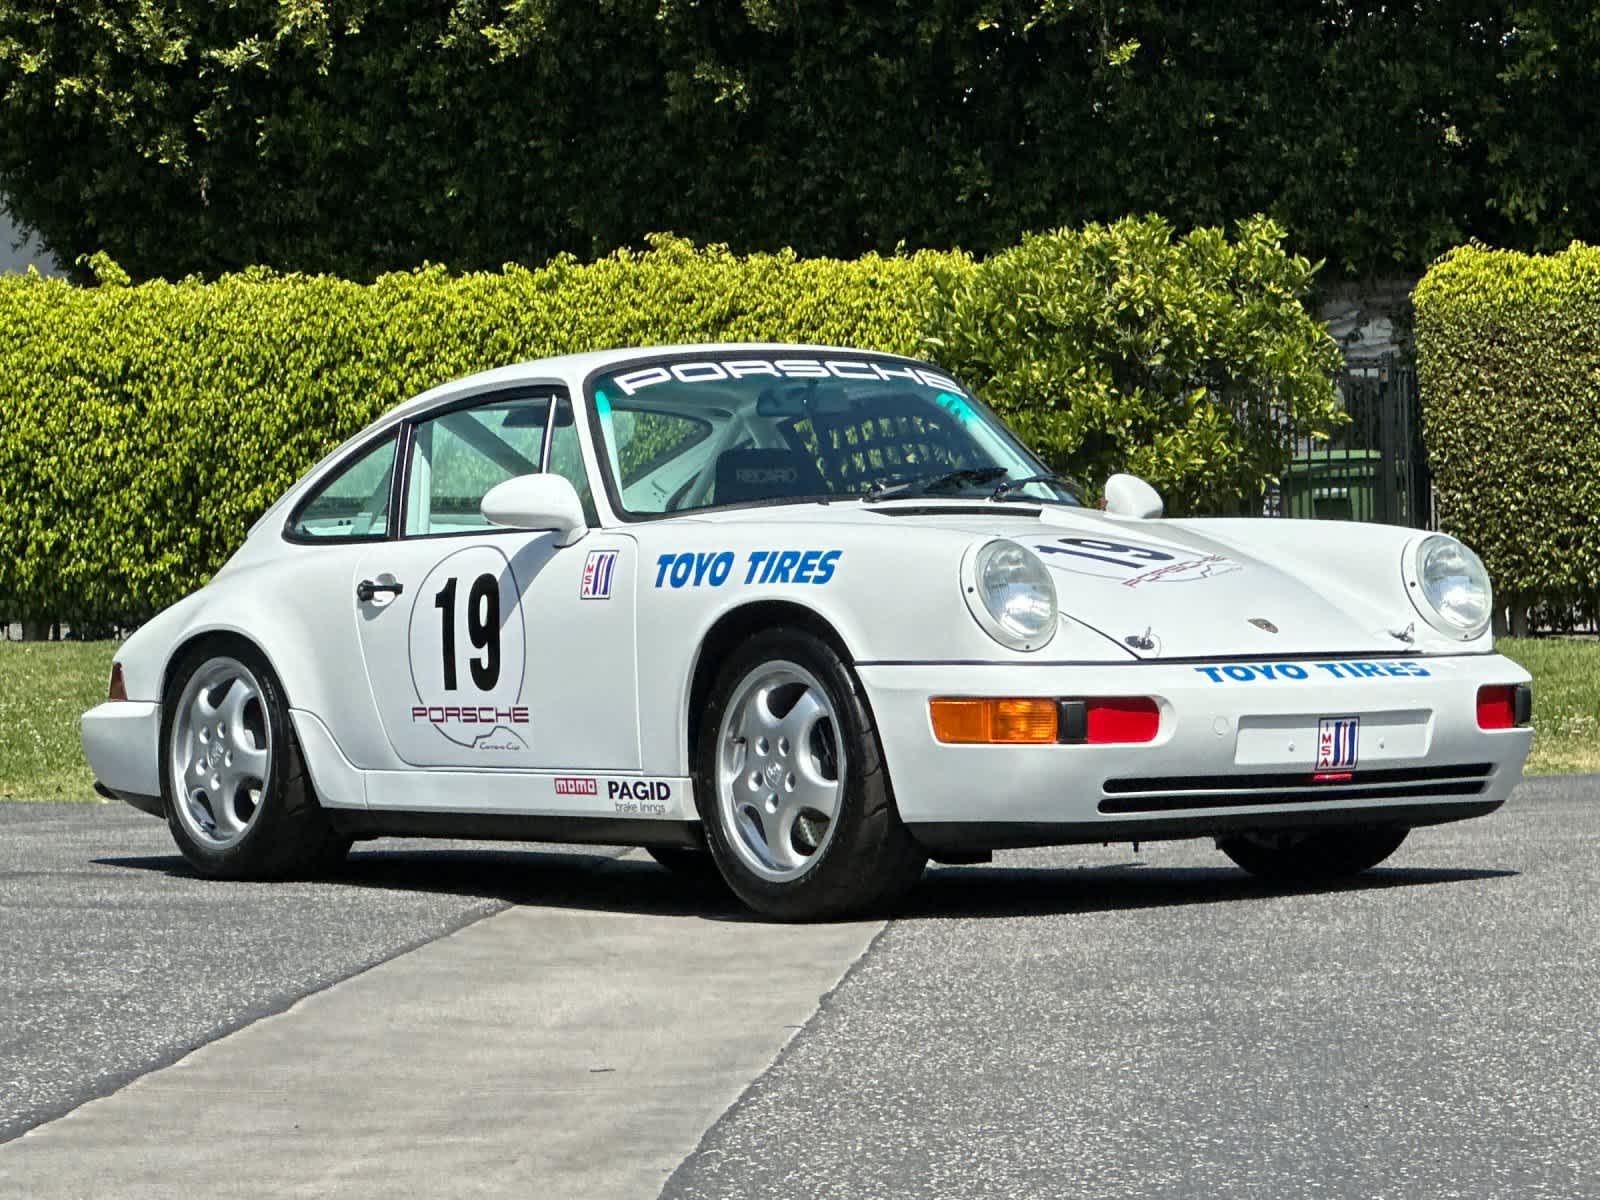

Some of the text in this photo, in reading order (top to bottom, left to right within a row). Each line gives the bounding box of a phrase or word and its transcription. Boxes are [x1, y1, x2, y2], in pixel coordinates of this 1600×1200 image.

[613, 359, 968, 398] PORSCHE
[1033, 537, 1176, 569] 19
[654, 550, 843, 588] TOYO TIRES
[434, 573, 501, 691] 19
[1194, 661, 1431, 683] TOYO TIRES
[411, 706, 530, 724] PORSCHE
[1320, 721, 1333, 768] IMSA
[555, 779, 597, 794] momo
[608, 780, 671, 801] PAGID
[615, 801, 665, 815] brake linings
